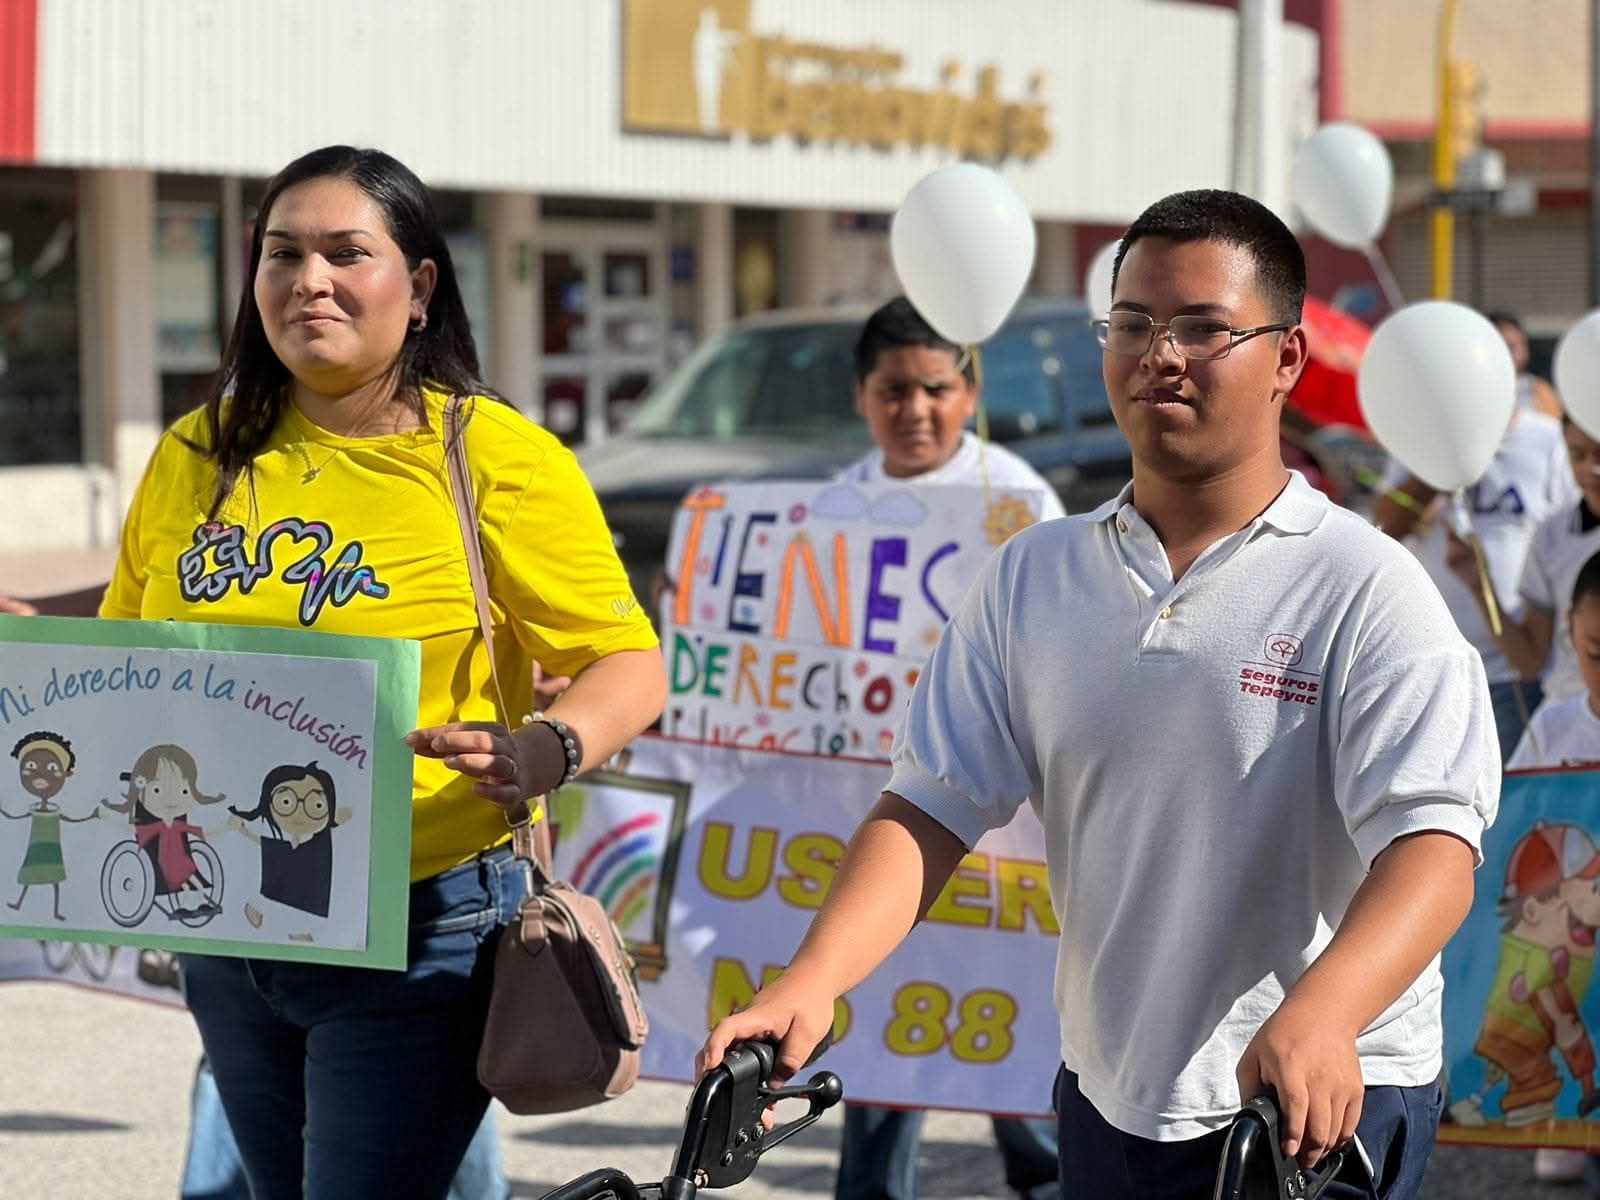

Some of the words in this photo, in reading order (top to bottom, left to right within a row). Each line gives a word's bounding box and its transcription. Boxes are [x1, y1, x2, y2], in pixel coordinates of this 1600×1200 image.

[672, 490, 961, 654] TIENES
[43, 656, 161, 707] derecho
[172, 667, 193, 691] a
[204, 664, 235, 701] la
[243, 681, 367, 769] inclusión
[1239, 668, 1320, 692] Seguros
[1239, 681, 1319, 705] Tepeyac
[696, 821, 1061, 936] USER
[882, 981, 1018, 1064] 88
